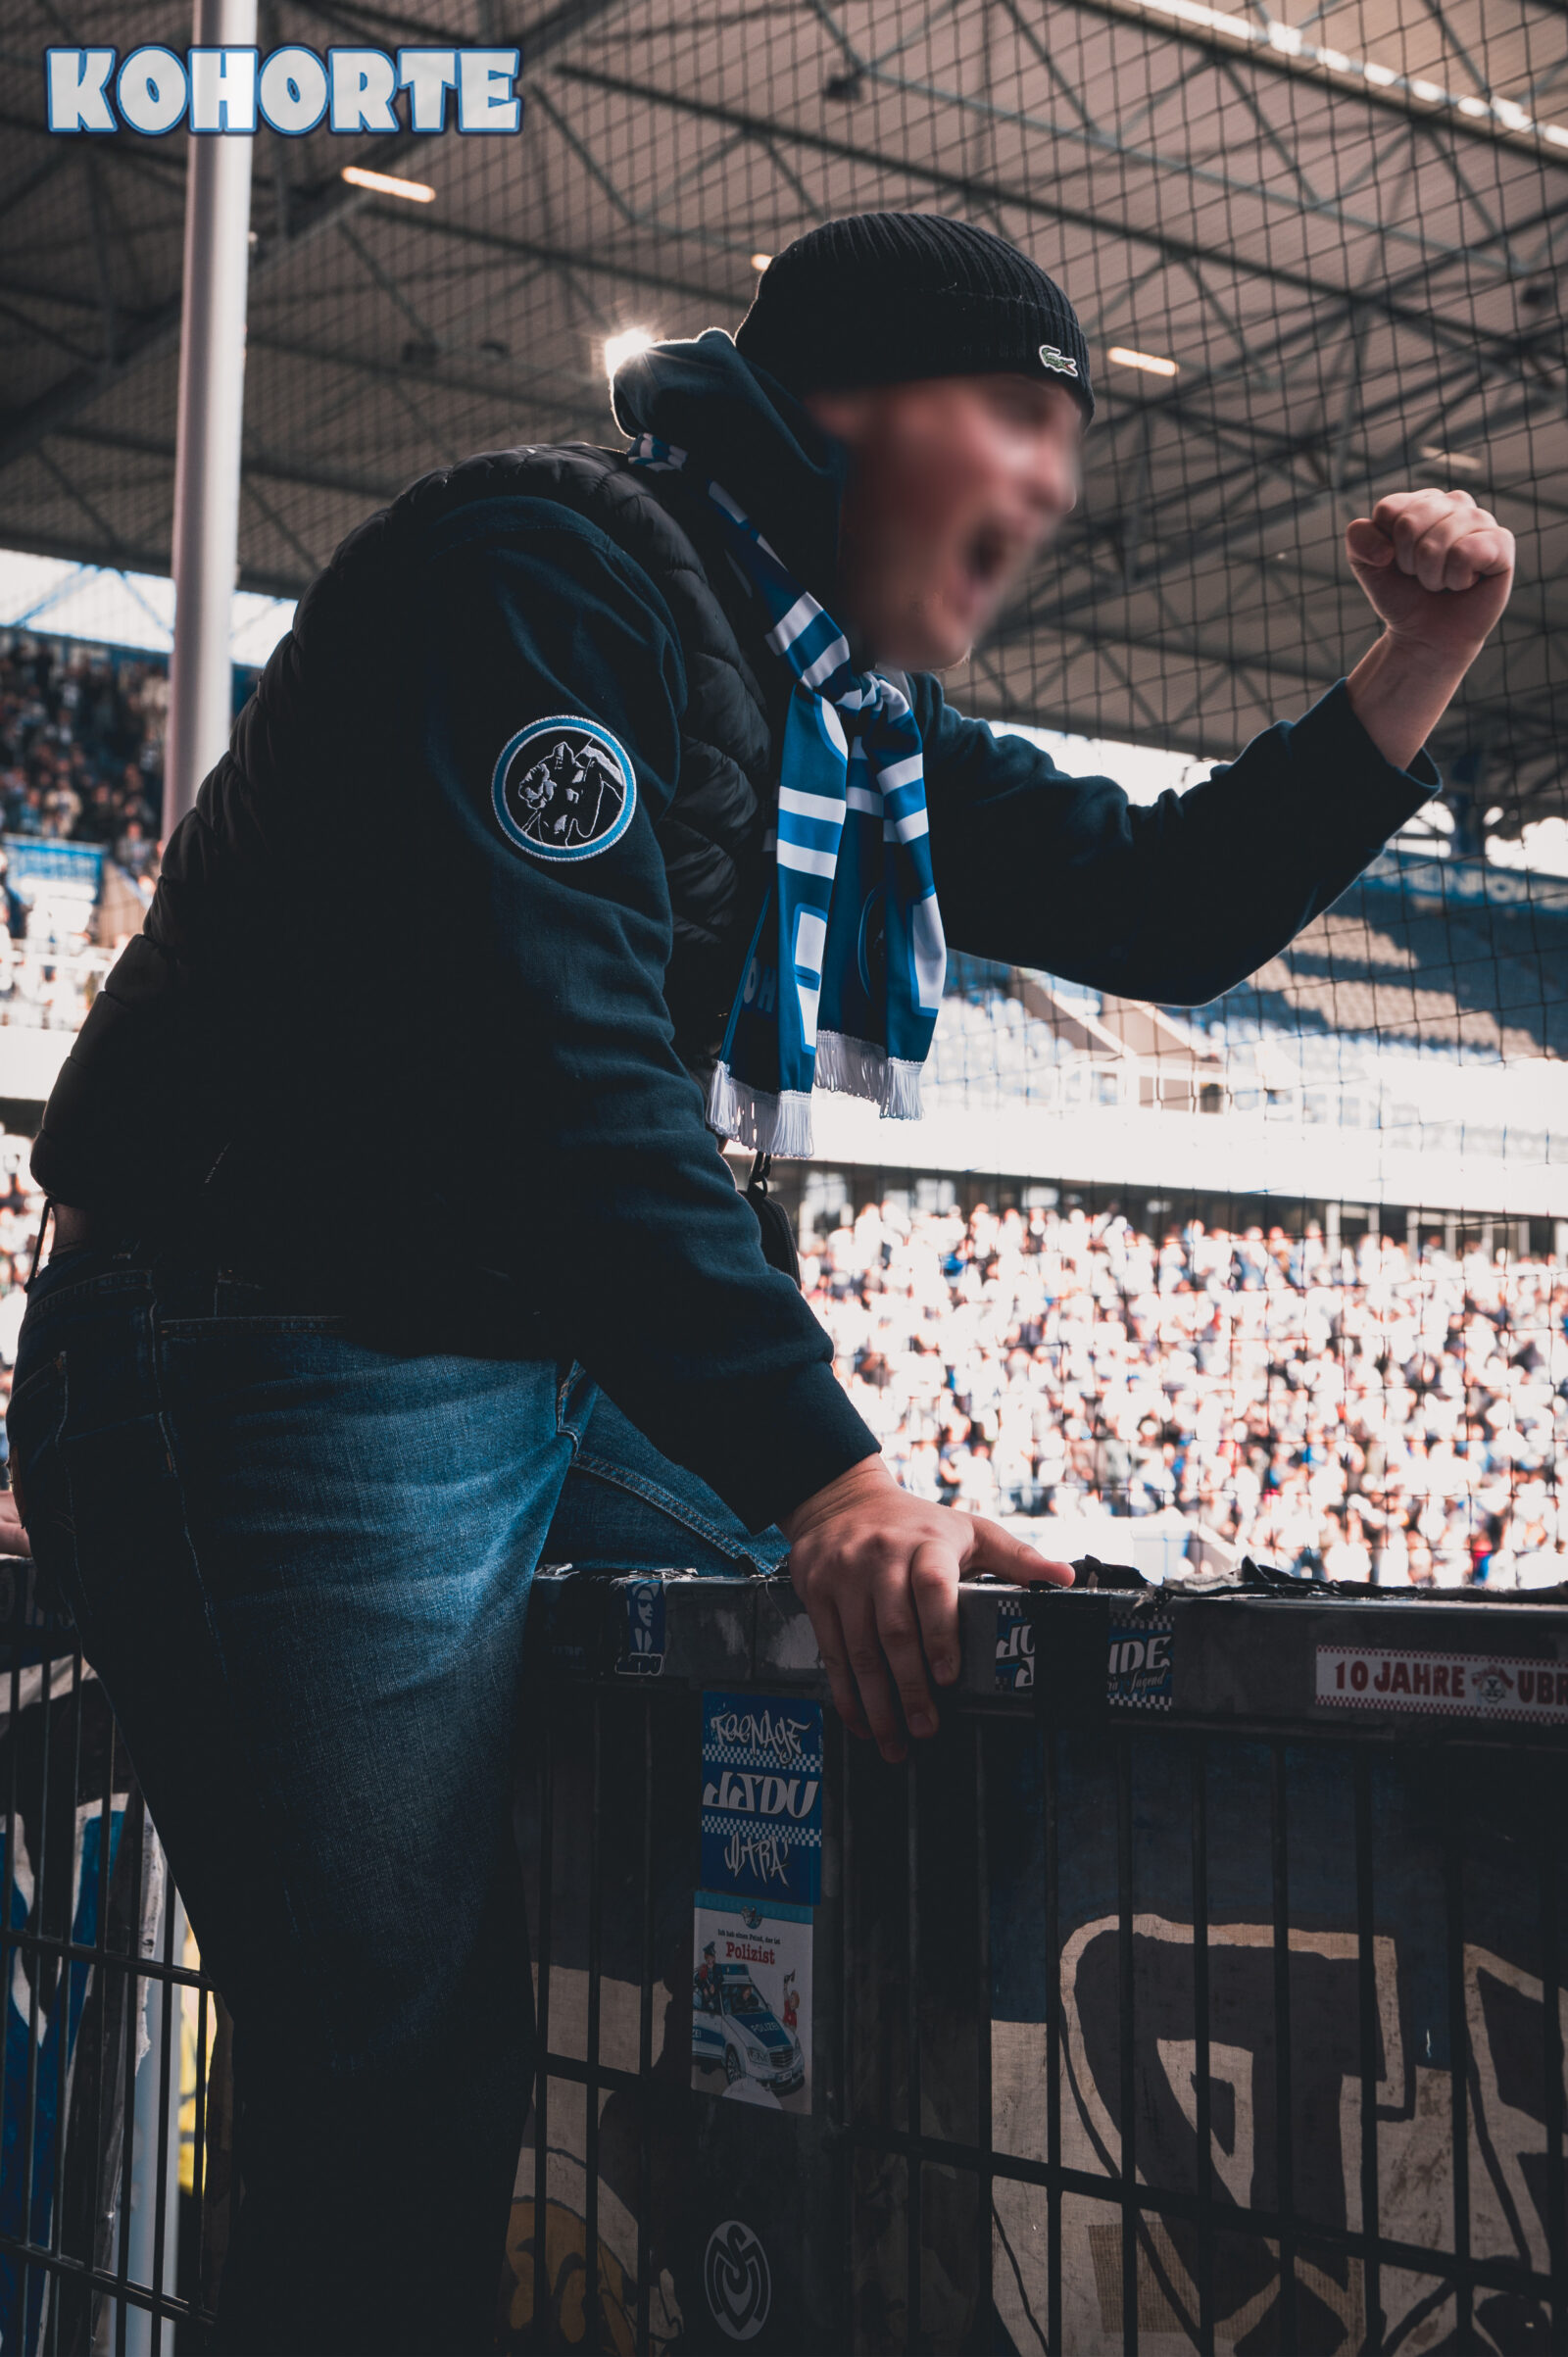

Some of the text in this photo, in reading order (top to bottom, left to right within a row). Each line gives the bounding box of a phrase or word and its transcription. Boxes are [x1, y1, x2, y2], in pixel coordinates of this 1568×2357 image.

[1335, 1661, 1368, 1692] 10
[1373, 1661, 1465, 1698] JAHRE
[726, 1941, 775, 1965] Polizist
